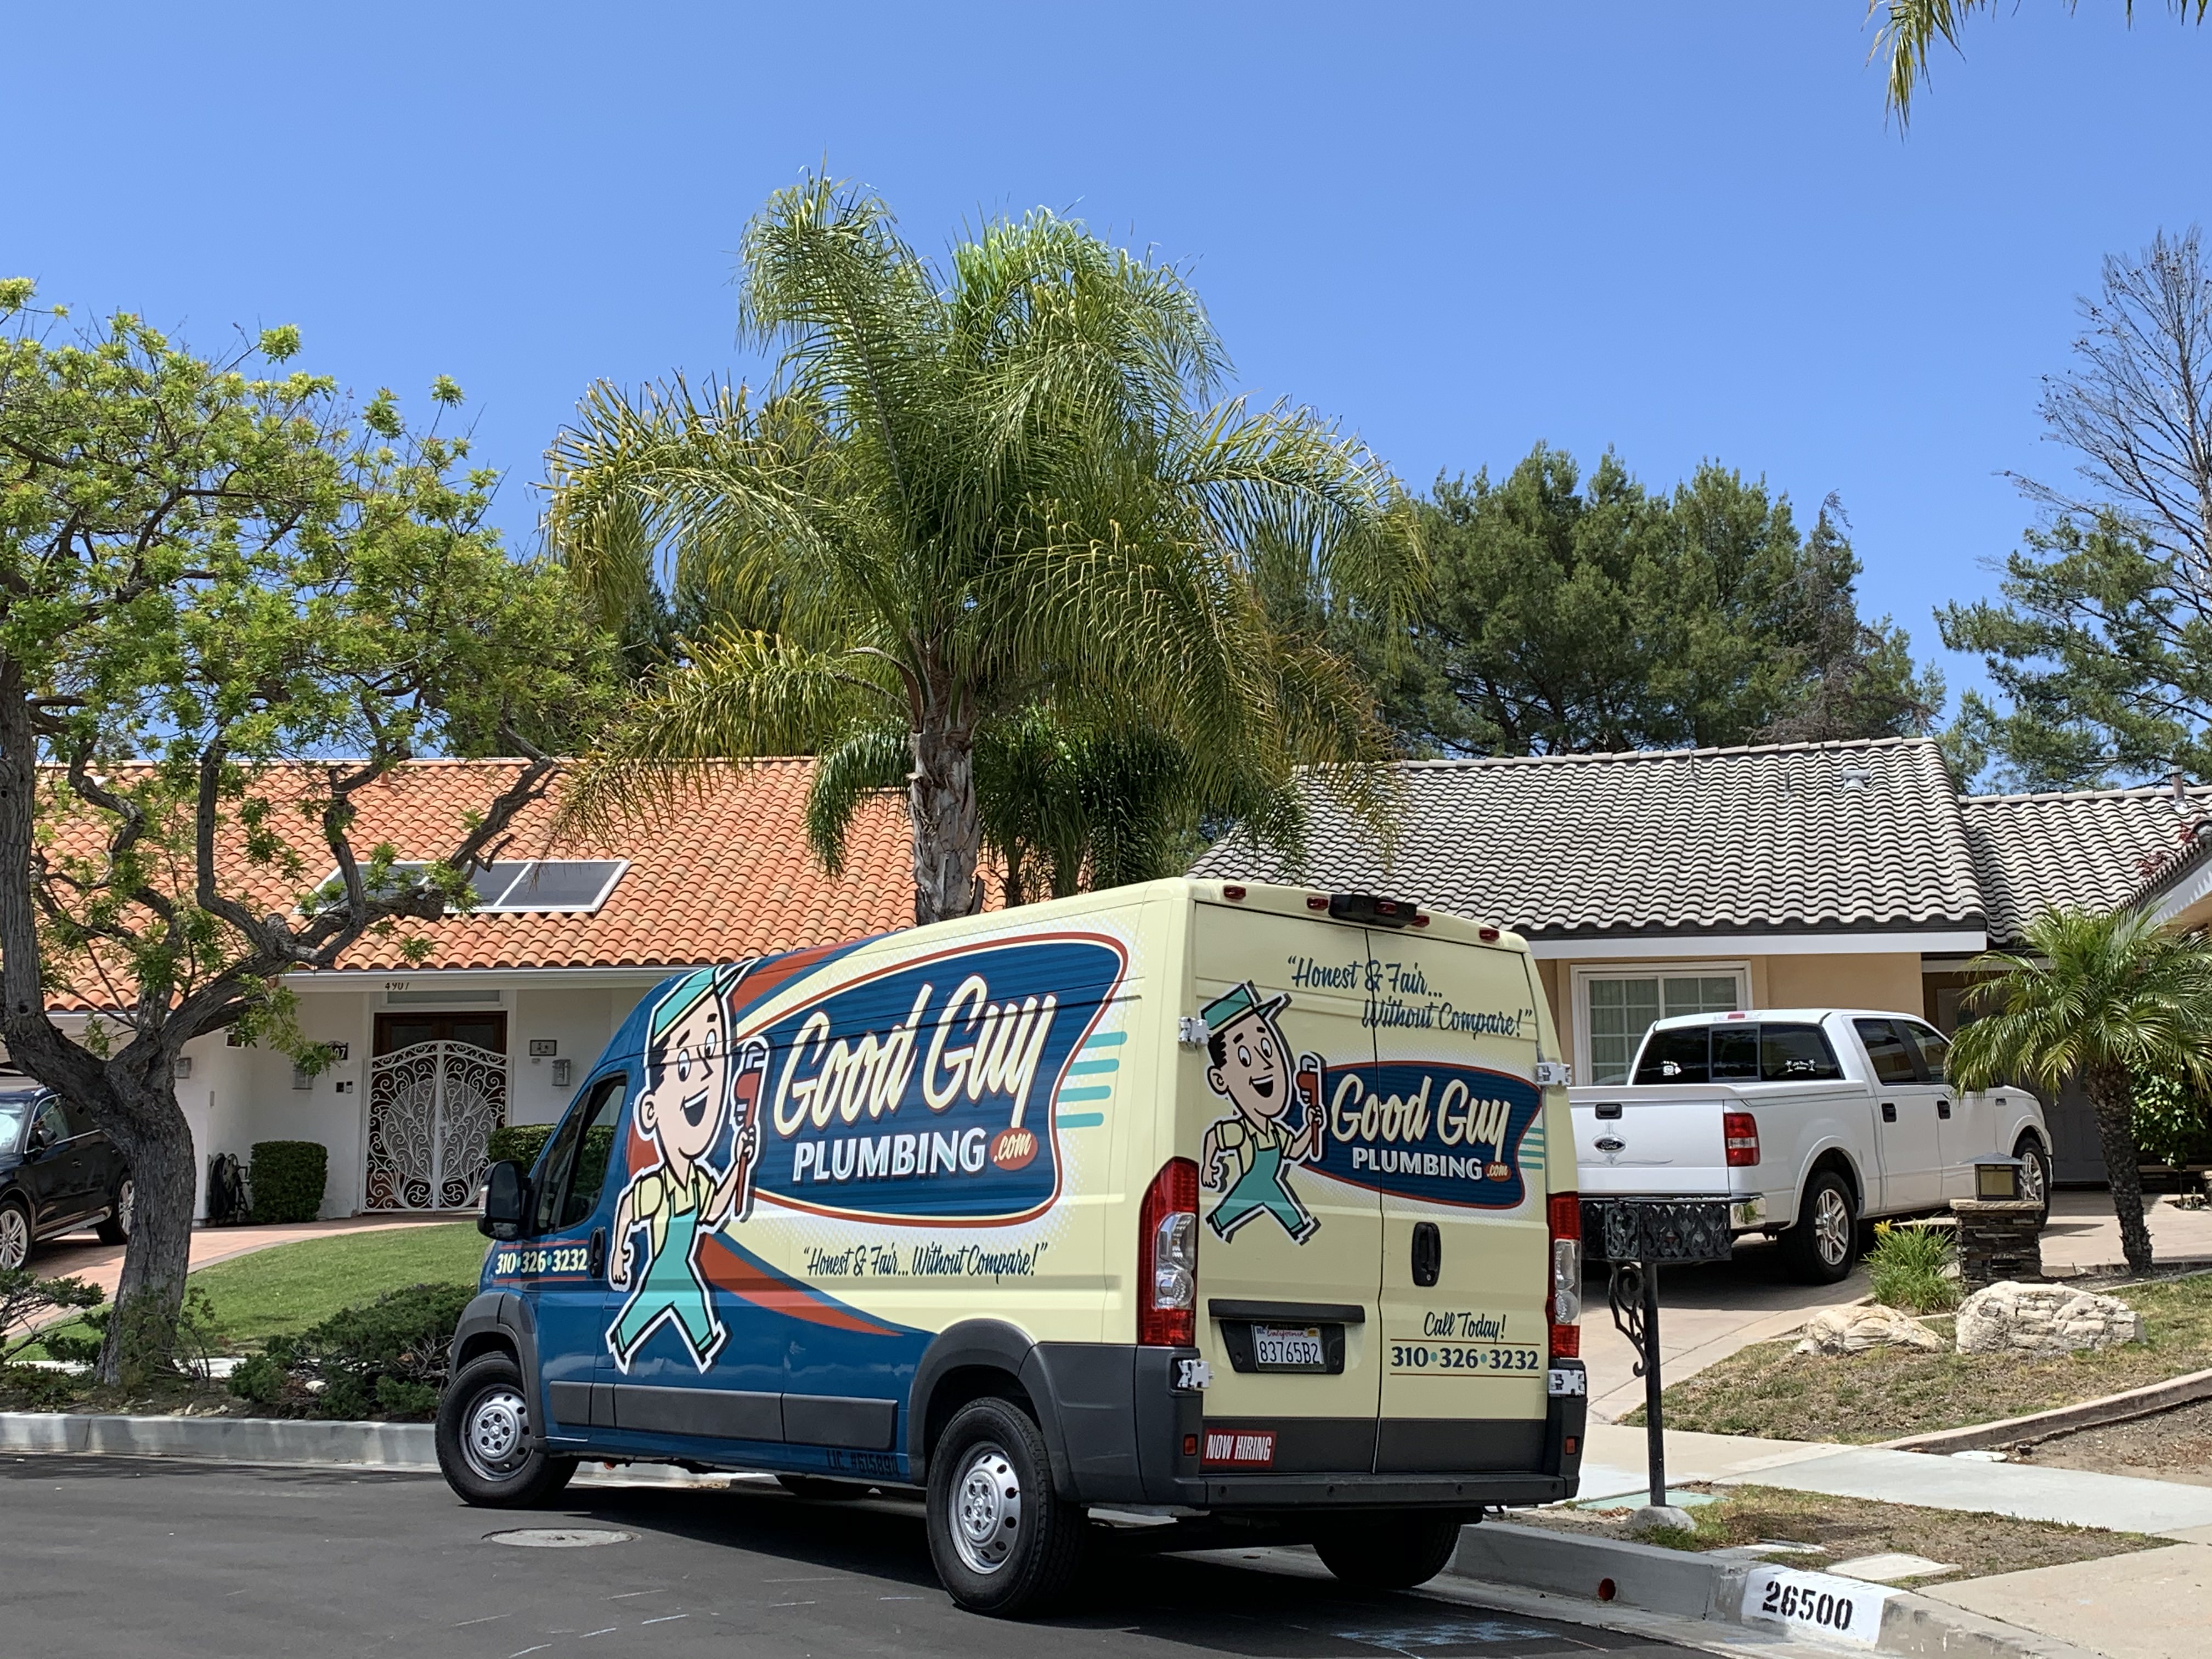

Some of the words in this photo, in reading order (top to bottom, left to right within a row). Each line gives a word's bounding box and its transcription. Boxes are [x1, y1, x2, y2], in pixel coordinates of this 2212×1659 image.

[1364, 960, 1383, 992] &
[1385, 962, 1443, 997] Fair...
[1362, 996, 1439, 1029] Without
[772, 982, 933, 1138] Good
[923, 974, 1057, 1128] Guy
[1331, 1073, 1432, 1143] Good
[1437, 1079, 1511, 1163] Guy
[792, 1127, 987, 1182] PLUMBING
[994, 1132, 1032, 1163] .com
[1352, 1147, 1482, 1180] PLUMBING
[1487, 1164, 1508, 1177] .com
[854, 1245, 866, 1277] &
[871, 1243, 909, 1276] Fair...
[912, 1242, 969, 1276] Without
[1424, 1312, 1455, 1336] Call
[1457, 1312, 1506, 1345] Today!
[1259, 1340, 1321, 1364] 83765B2
[1206, 1434, 1234, 1459] NOW
[1234, 1435, 1272, 1461] HIRING
[1762, 1581, 1853, 1630] 26500
